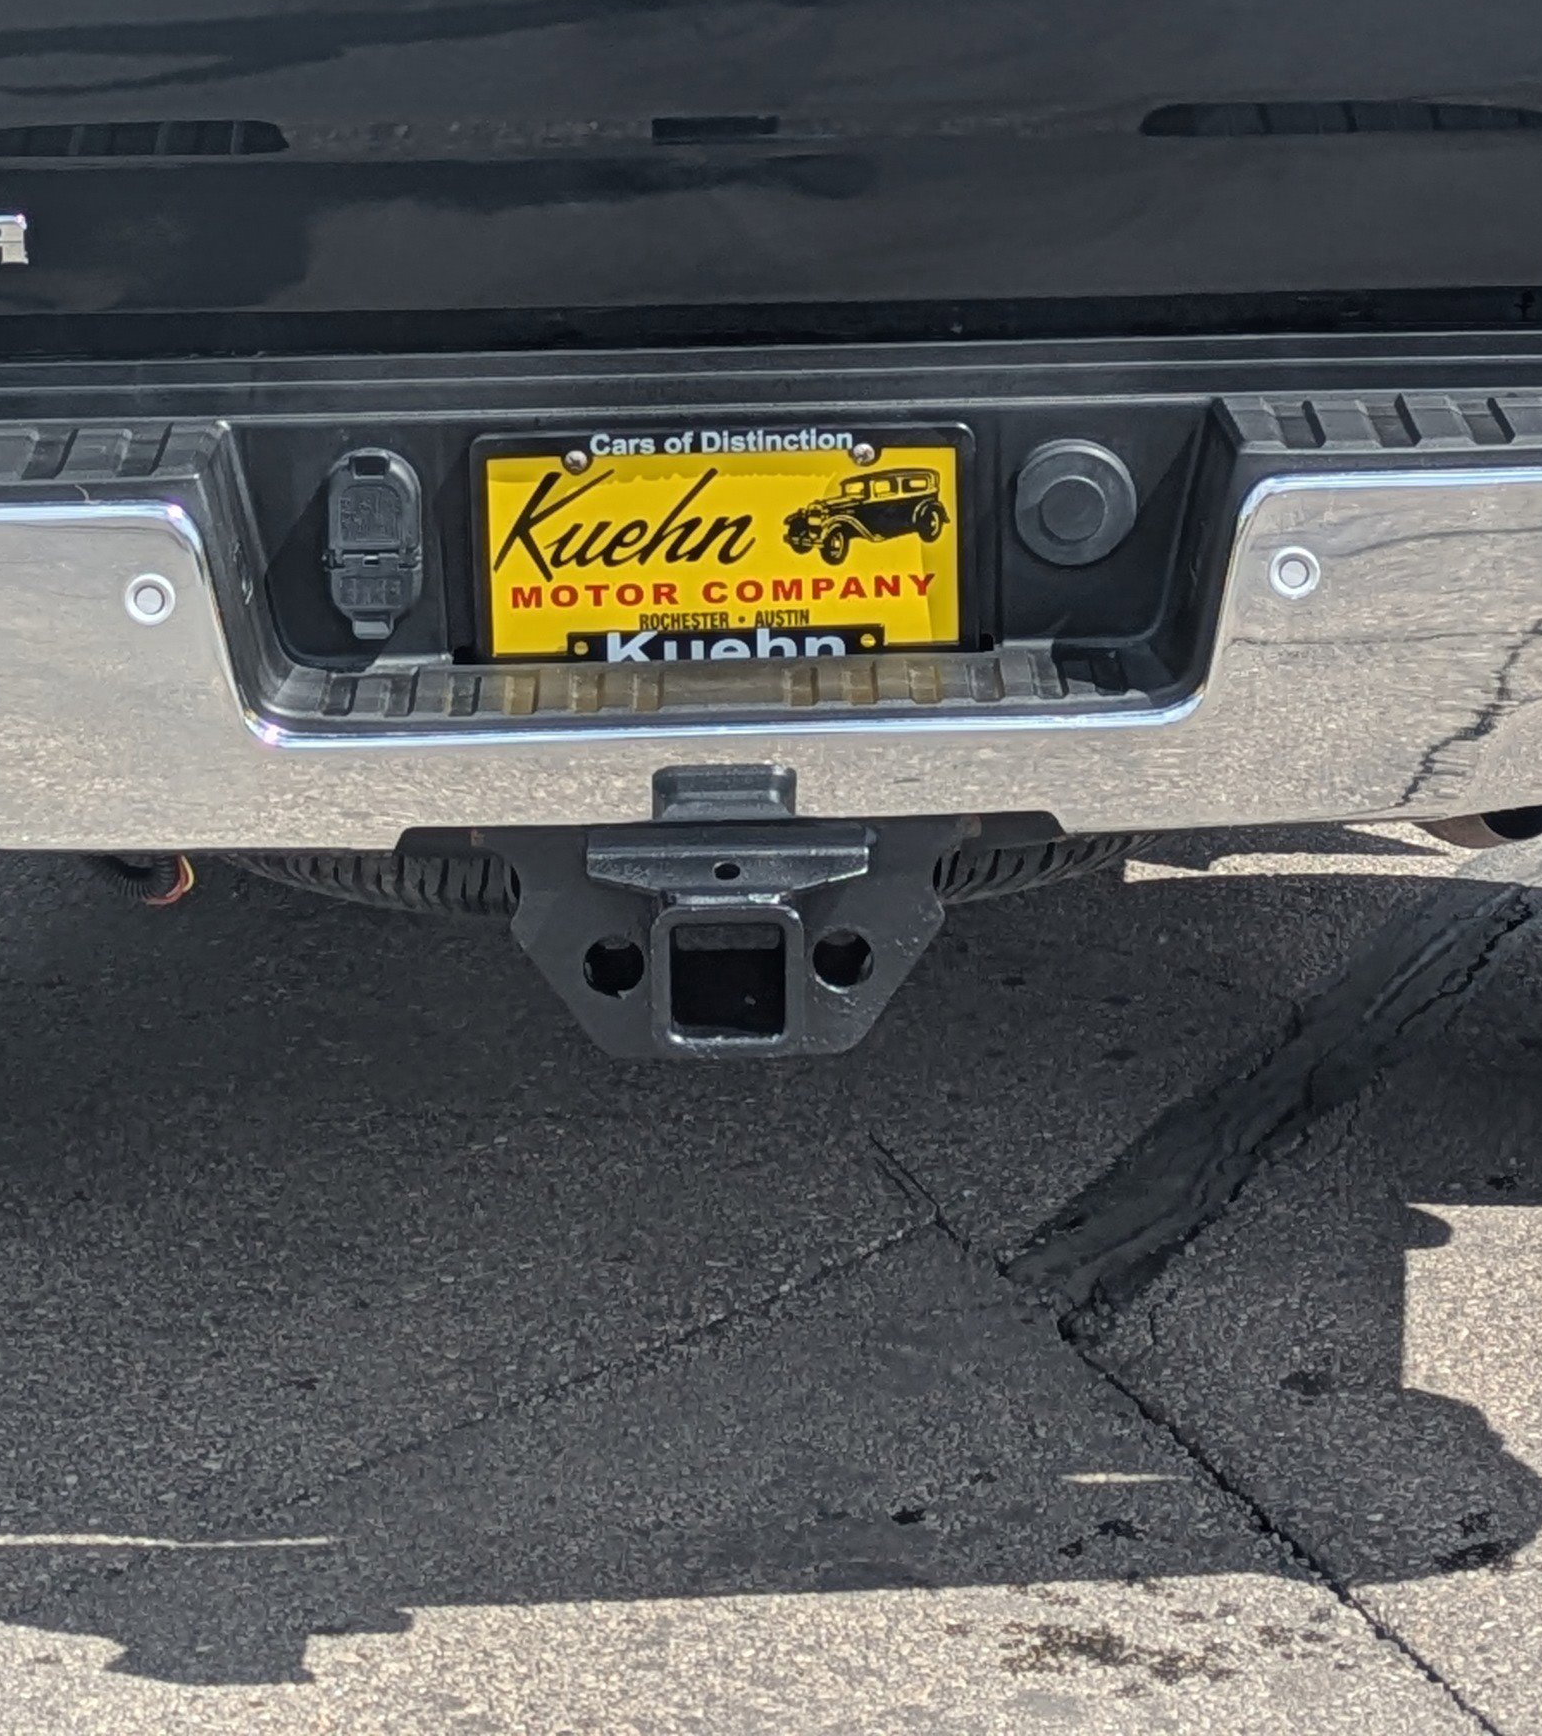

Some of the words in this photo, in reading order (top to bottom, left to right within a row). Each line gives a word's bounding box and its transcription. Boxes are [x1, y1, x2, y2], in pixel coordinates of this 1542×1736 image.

[590, 433, 655, 457] Cars
[664, 431, 695, 455] of
[701, 428, 854, 454] Distinction
[493, 467, 756, 582] Kuehn
[512, 581, 680, 609] MOTOR
[701, 573, 935, 605] COMPANY
[639, 610, 730, 631] ROCHESTER
[755, 608, 810, 629] AUSTIN
[606, 628, 847, 664] Kuehn
